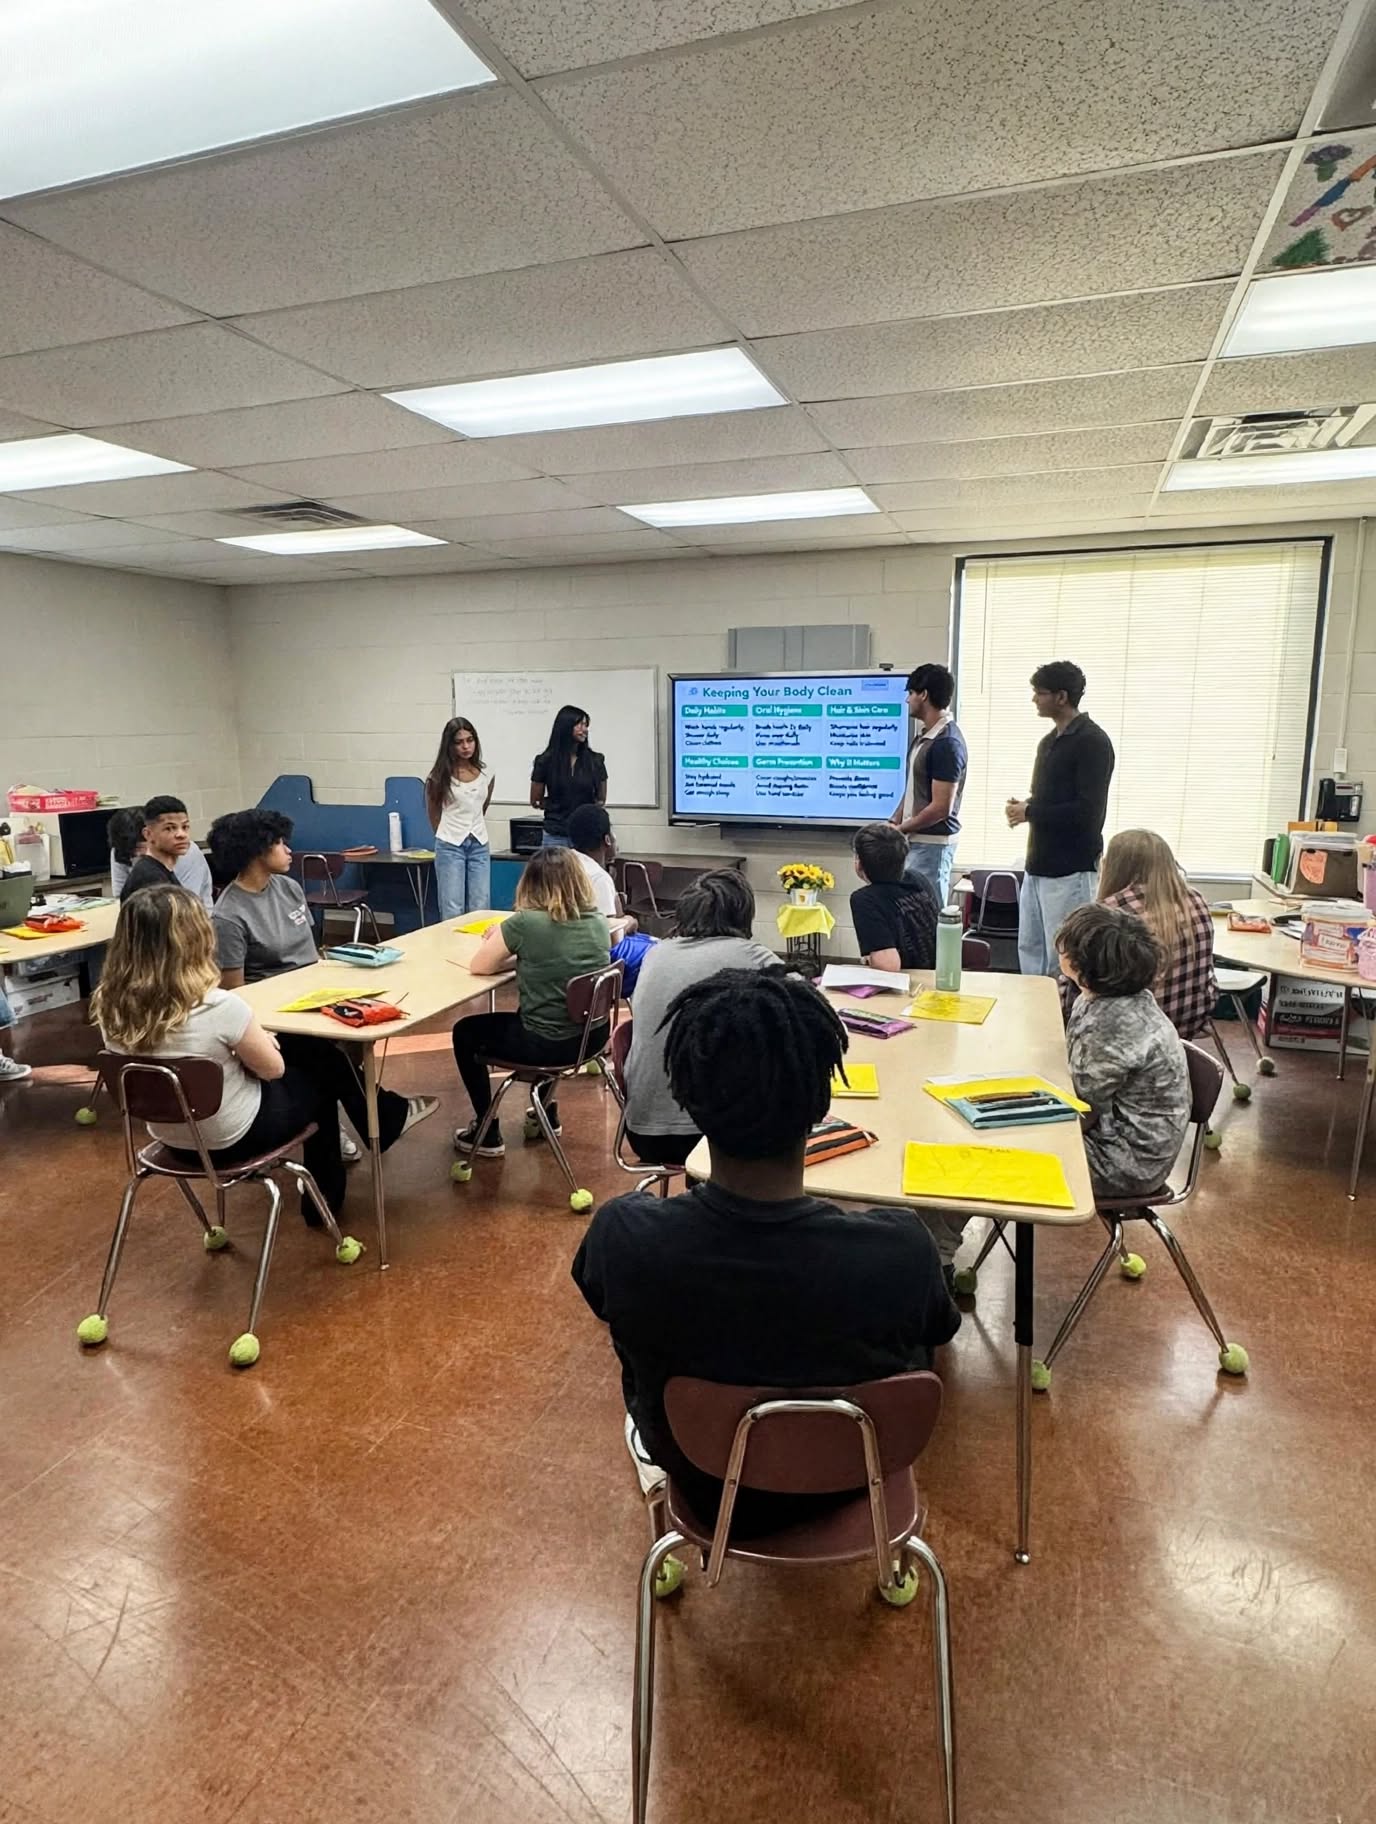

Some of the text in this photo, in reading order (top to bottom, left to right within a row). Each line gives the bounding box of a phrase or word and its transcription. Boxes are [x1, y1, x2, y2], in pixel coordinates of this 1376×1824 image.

[703, 686, 852, 700] Keeping Your Body Clean
[685, 706, 726, 716] Daily Habits
[755, 706, 802, 716] Oral Hygiene
[830, 705, 845, 714] Hair
[854, 705, 870, 714] Skin
[871, 706, 889, 714] Care
[685, 758, 739, 767] Healthy Choices
[756, 758, 776, 766] Germ
[828, 758, 845, 768] Why
[853, 759, 880, 767] Matters
